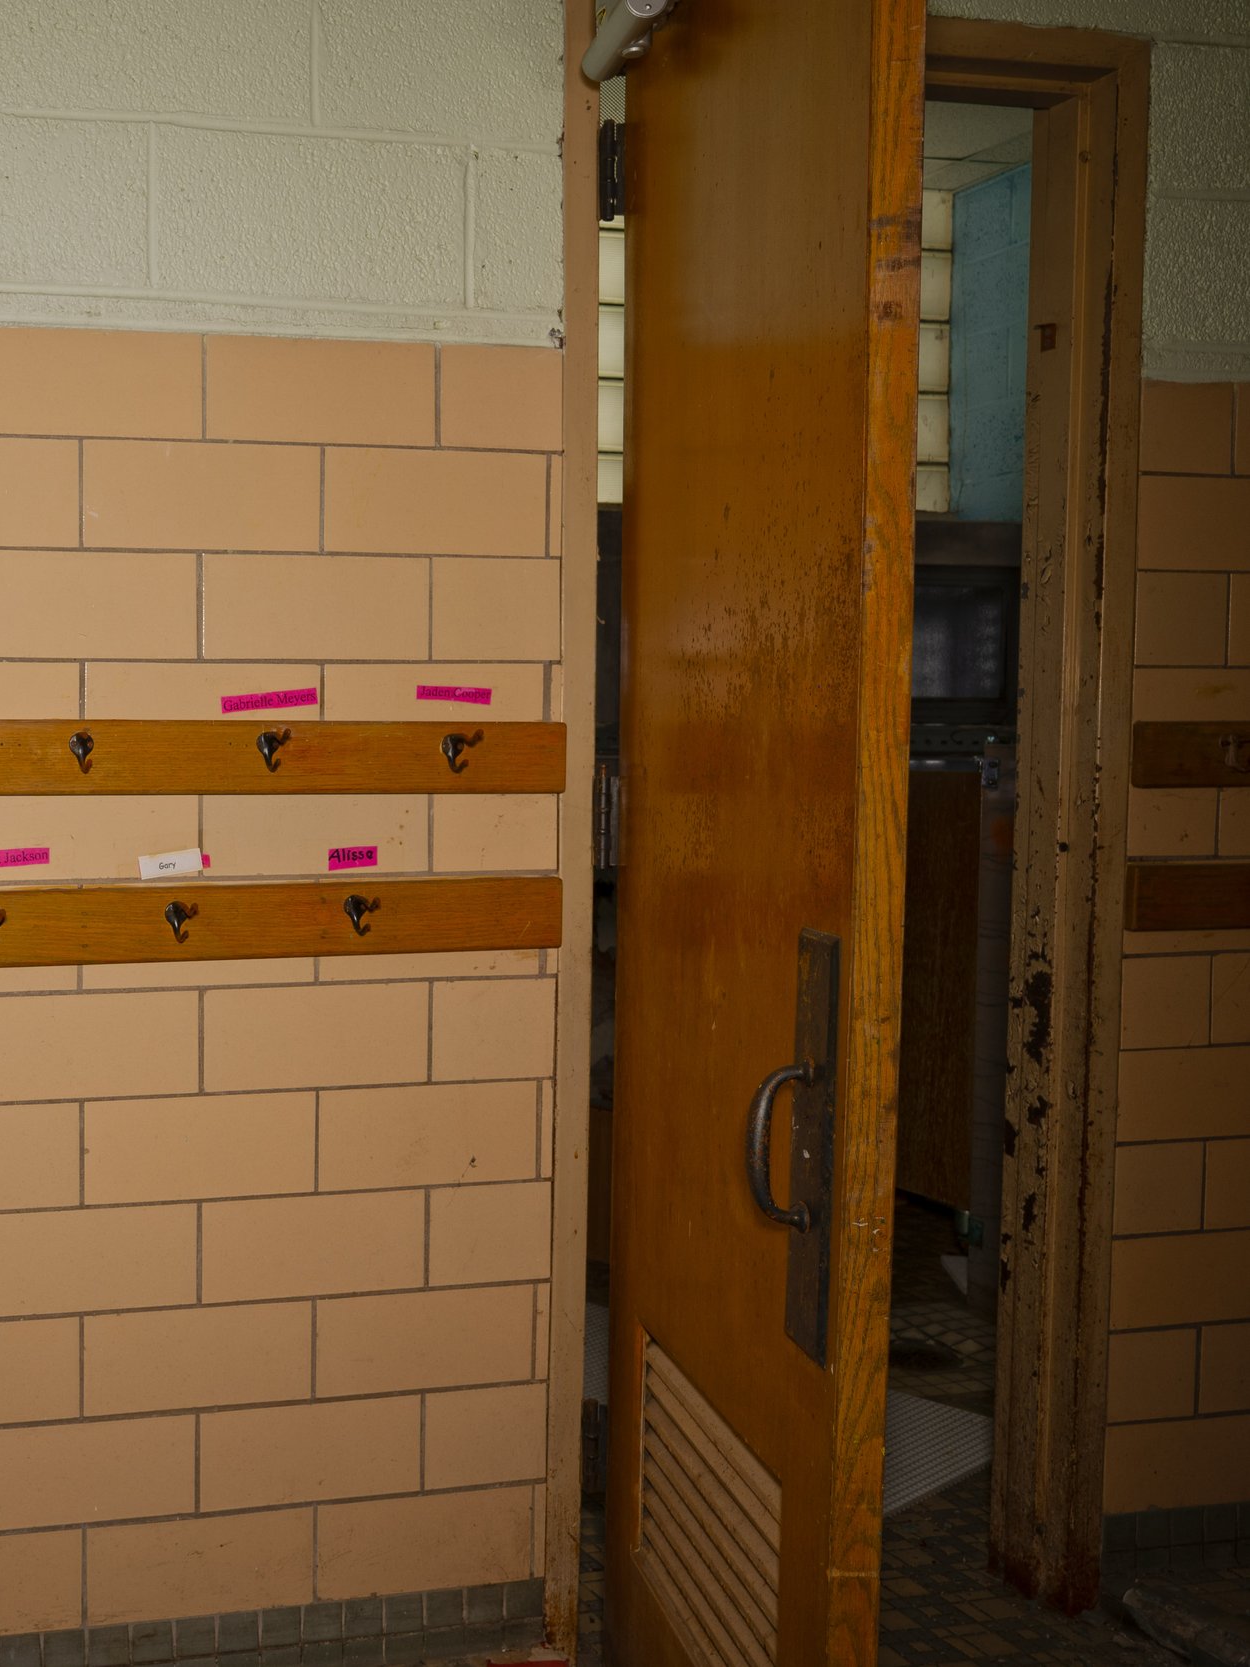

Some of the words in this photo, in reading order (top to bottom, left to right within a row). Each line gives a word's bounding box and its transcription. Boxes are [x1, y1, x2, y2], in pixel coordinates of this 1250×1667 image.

[421, 686, 450, 697] Jaden
[453, 687, 492, 700] Cooper
[223, 696, 273, 711] Gabrielle
[276, 692, 317, 706] Meyers
[4, 850, 49, 864] Jackson
[158, 862, 176, 870] Gary
